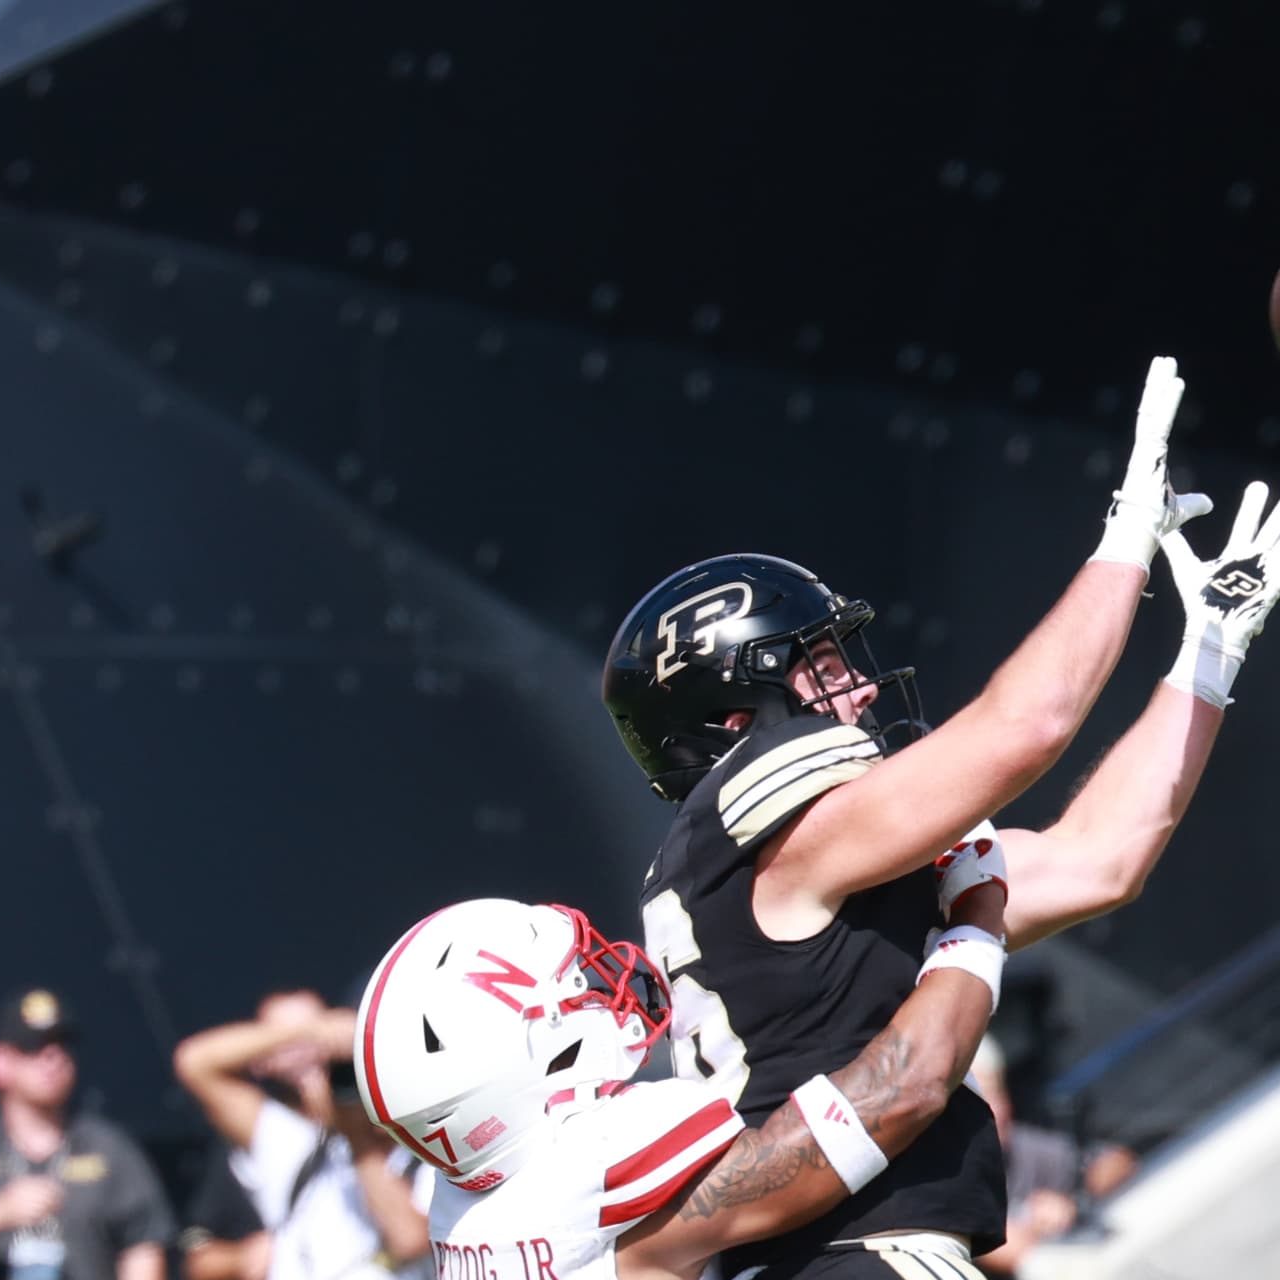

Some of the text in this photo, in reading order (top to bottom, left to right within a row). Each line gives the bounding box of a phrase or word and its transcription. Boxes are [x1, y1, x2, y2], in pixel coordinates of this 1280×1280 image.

[657, 582, 752, 682] P
[462, 949, 538, 1013] N
[422, 1126, 458, 1164] 7
